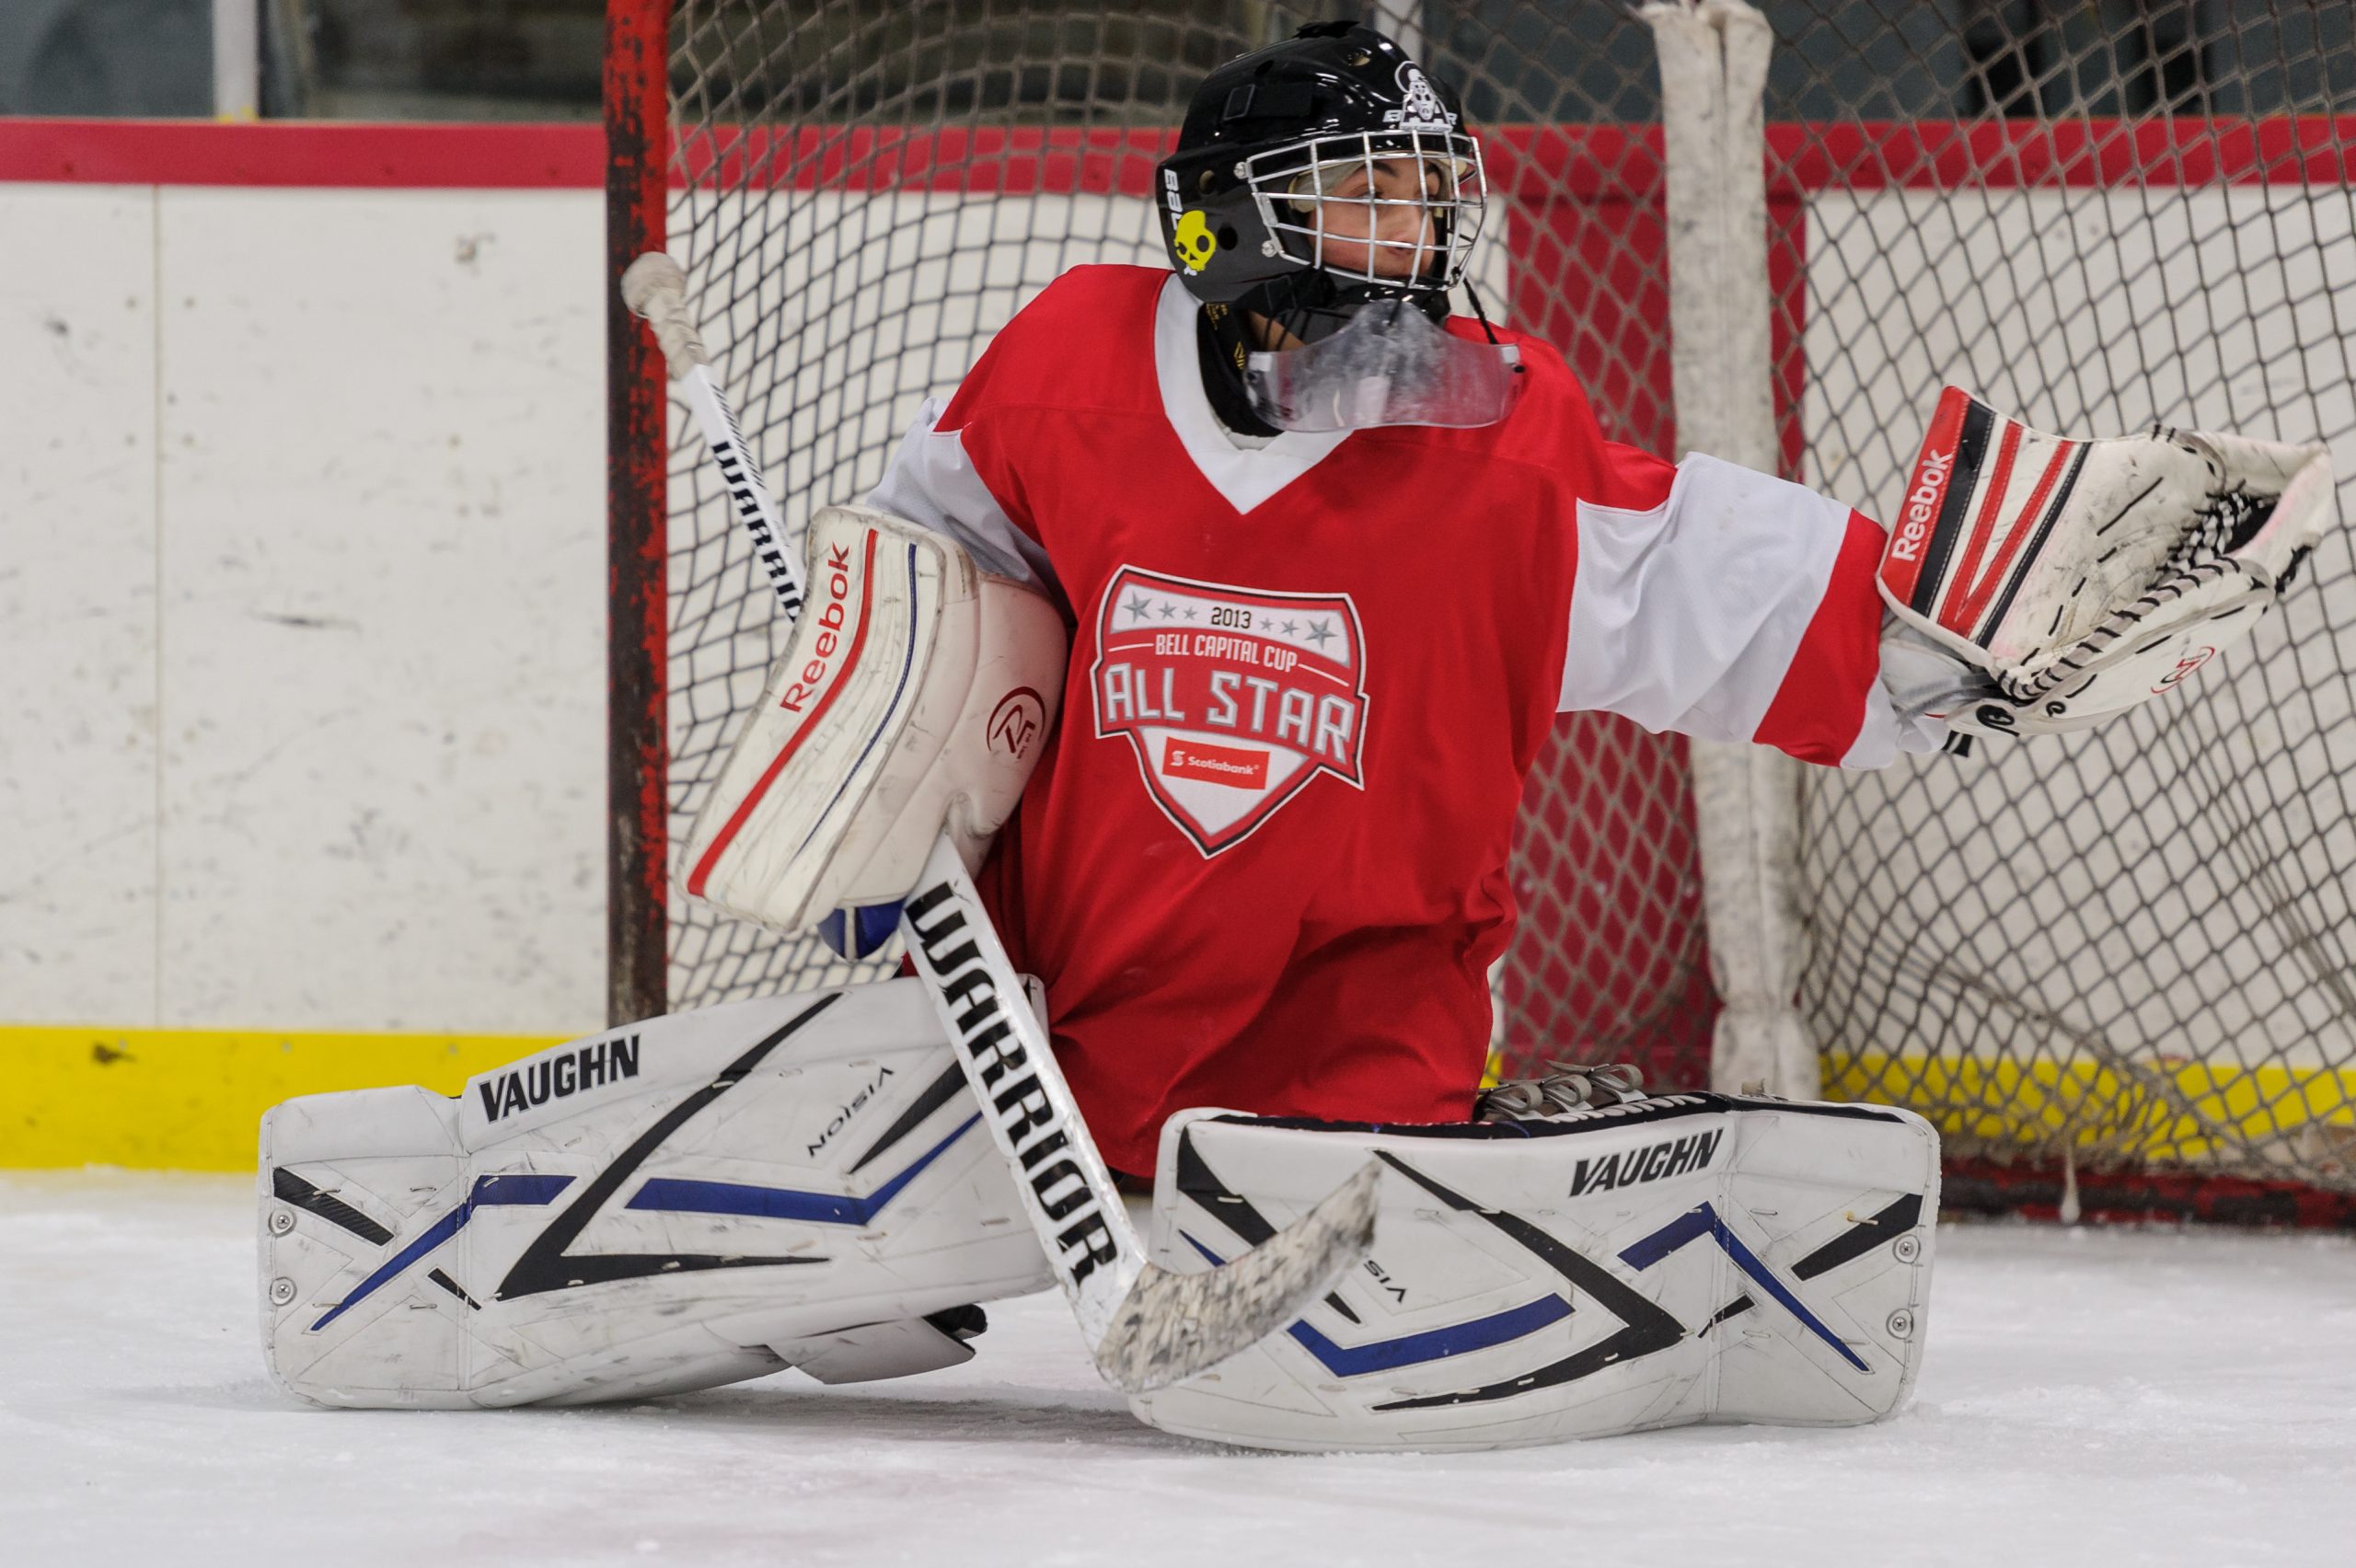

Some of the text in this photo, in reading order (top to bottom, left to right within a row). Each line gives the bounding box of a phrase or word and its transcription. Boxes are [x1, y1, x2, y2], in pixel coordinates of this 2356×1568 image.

[1891, 449, 1953, 561] Reebok
[780, 541, 849, 712] Reebok
[1155, 633, 1299, 673] BELL CAPITAL CUP
[1210, 606, 1252, 629] 2013
[1104, 663, 1355, 765] ALL STAR
[478, 1032, 641, 1124] VAUGHN
[807, 1066, 894, 1158] VISION
[905, 882, 1118, 1288] WARRIOR
[1568, 1129, 1725, 1197] VAUGHN
